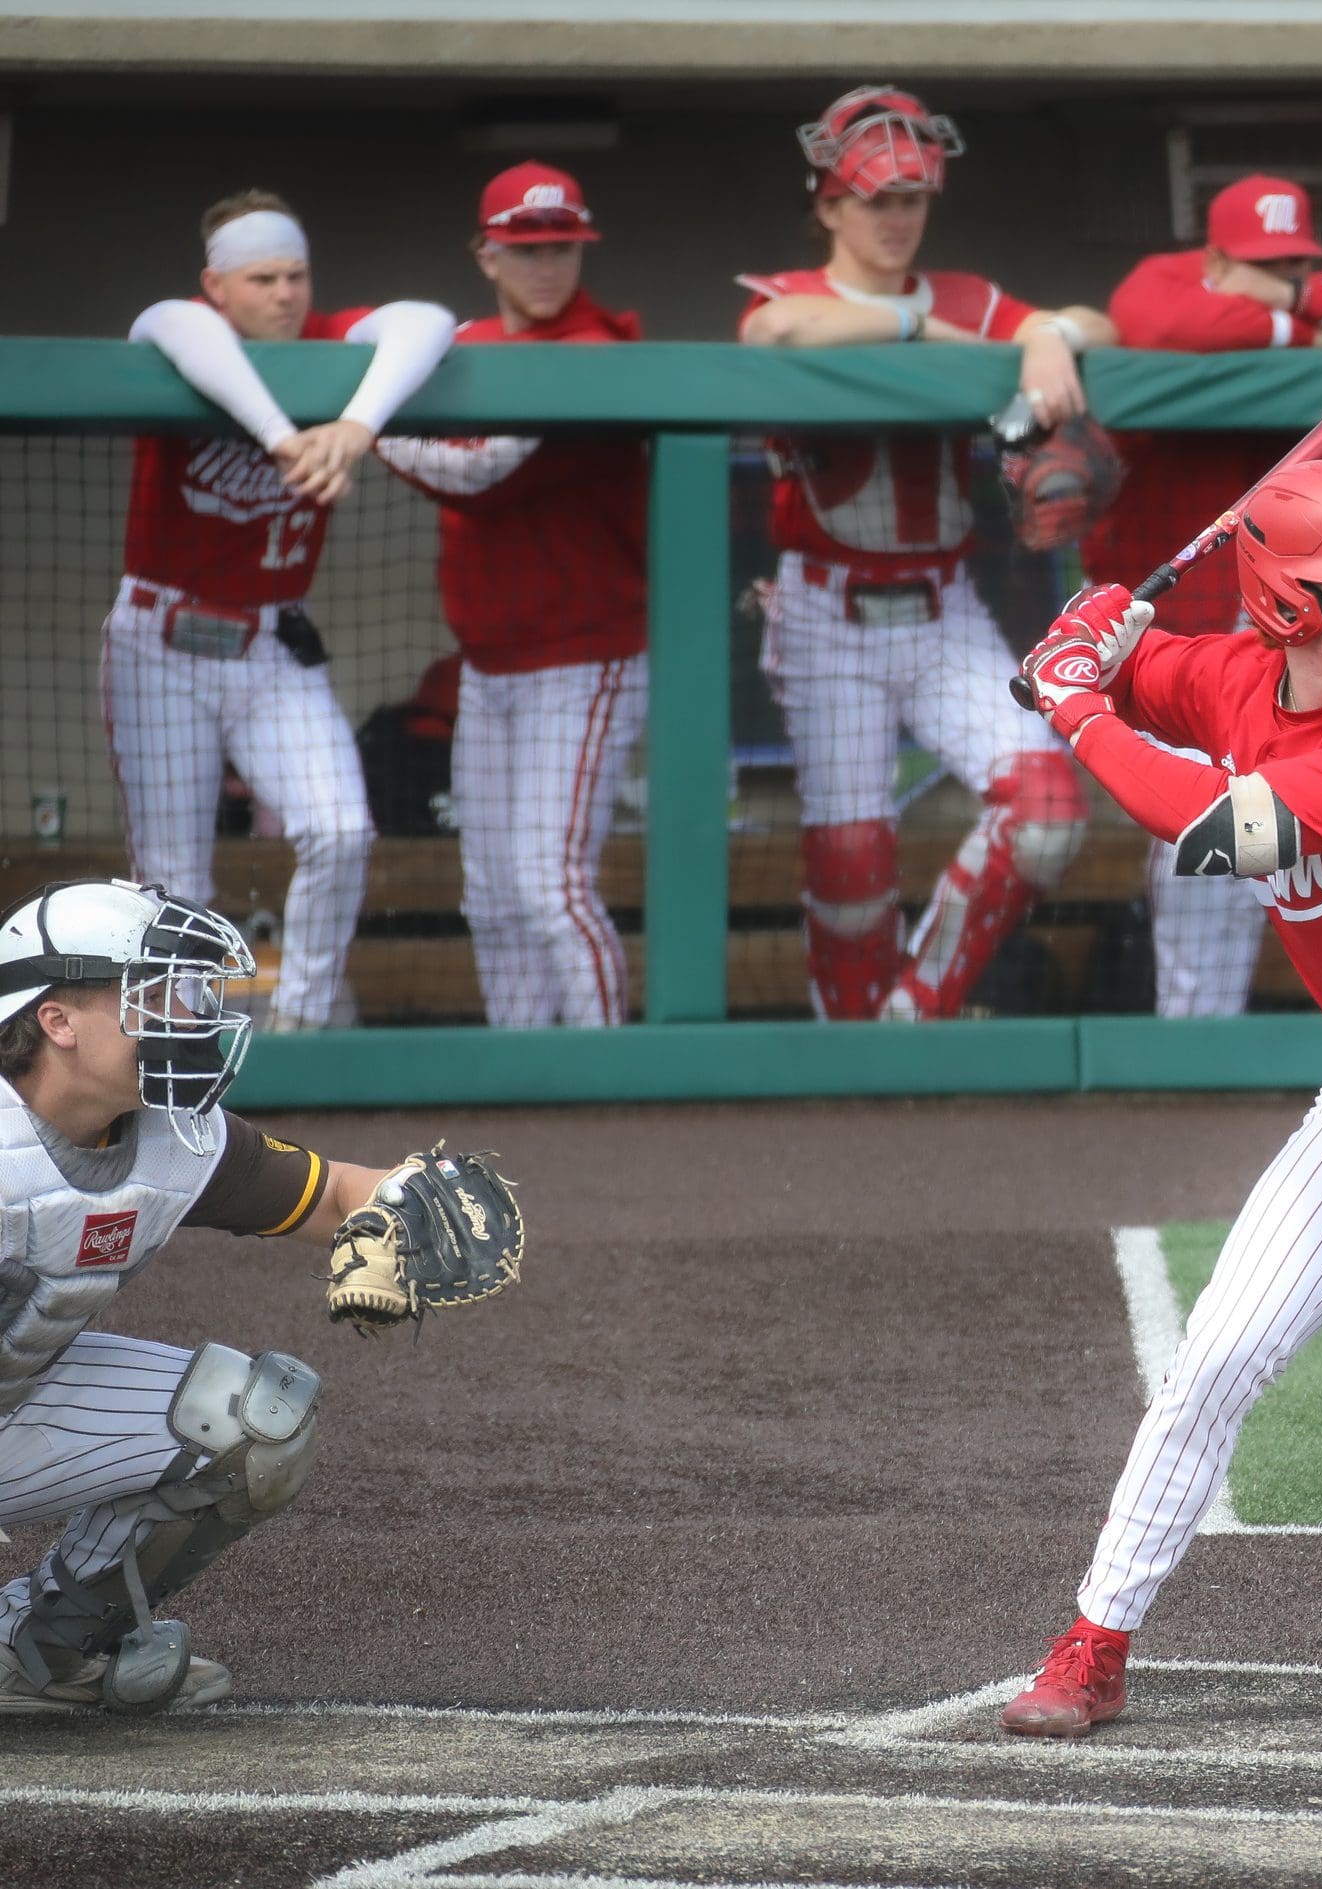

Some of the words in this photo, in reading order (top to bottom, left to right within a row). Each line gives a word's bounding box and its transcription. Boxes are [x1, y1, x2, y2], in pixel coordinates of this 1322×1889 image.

[1254, 193, 1300, 235] M
[454, 1186, 490, 1241] Rawlings
[83, 1226, 132, 1250] Rawlings
